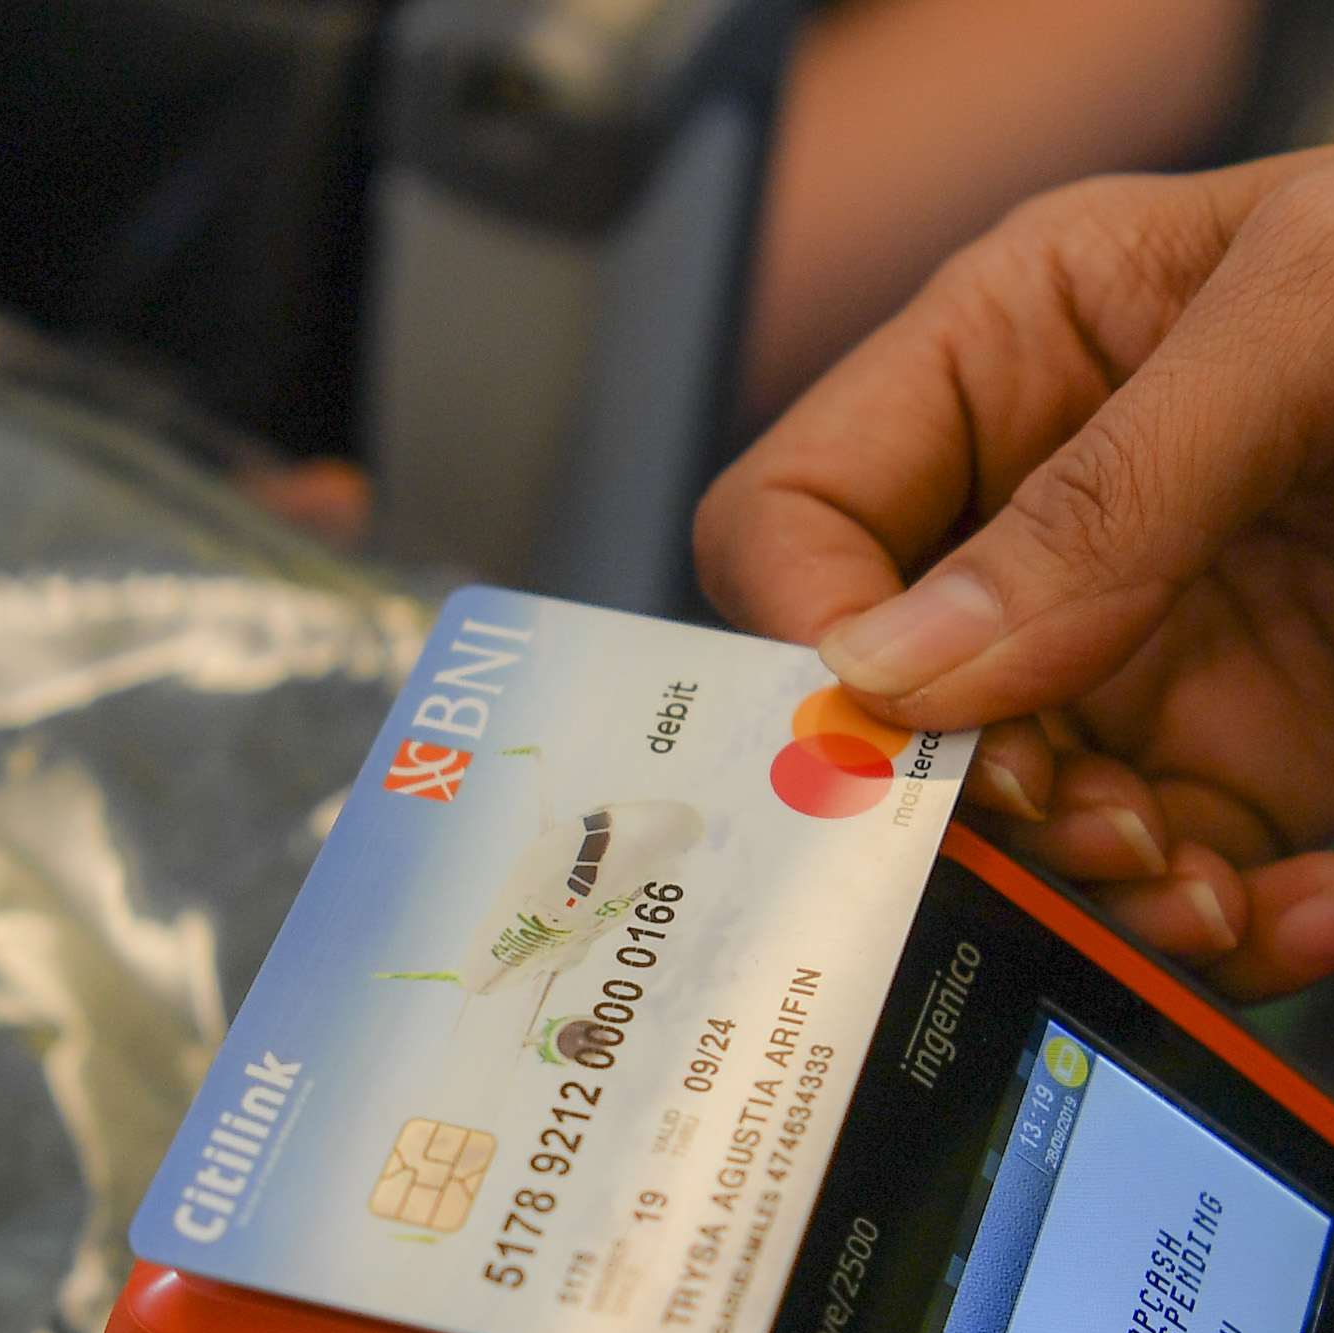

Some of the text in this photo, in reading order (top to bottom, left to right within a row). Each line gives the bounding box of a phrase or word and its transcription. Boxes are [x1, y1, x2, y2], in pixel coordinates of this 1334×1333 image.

[414, 619, 533, 738] BNI
[646, 682, 697, 753] debit
[683, 1019, 735, 1092] 09/24
[900, 942, 980, 1088] ingenico
[483, 881, 683, 1288] 5178 9212 0000 0166
[767, 1044, 833, 1181] 474634333
[1018, 1083, 1053, 1147] 13:19
[1044, 1096, 1076, 1168] 28/09/2019
[173, 1051, 301, 1242] Citilink
[633, 1190, 667, 1221] 19
[660, 967, 821, 1325] TRYSA AGUSTIA ARIFIN
